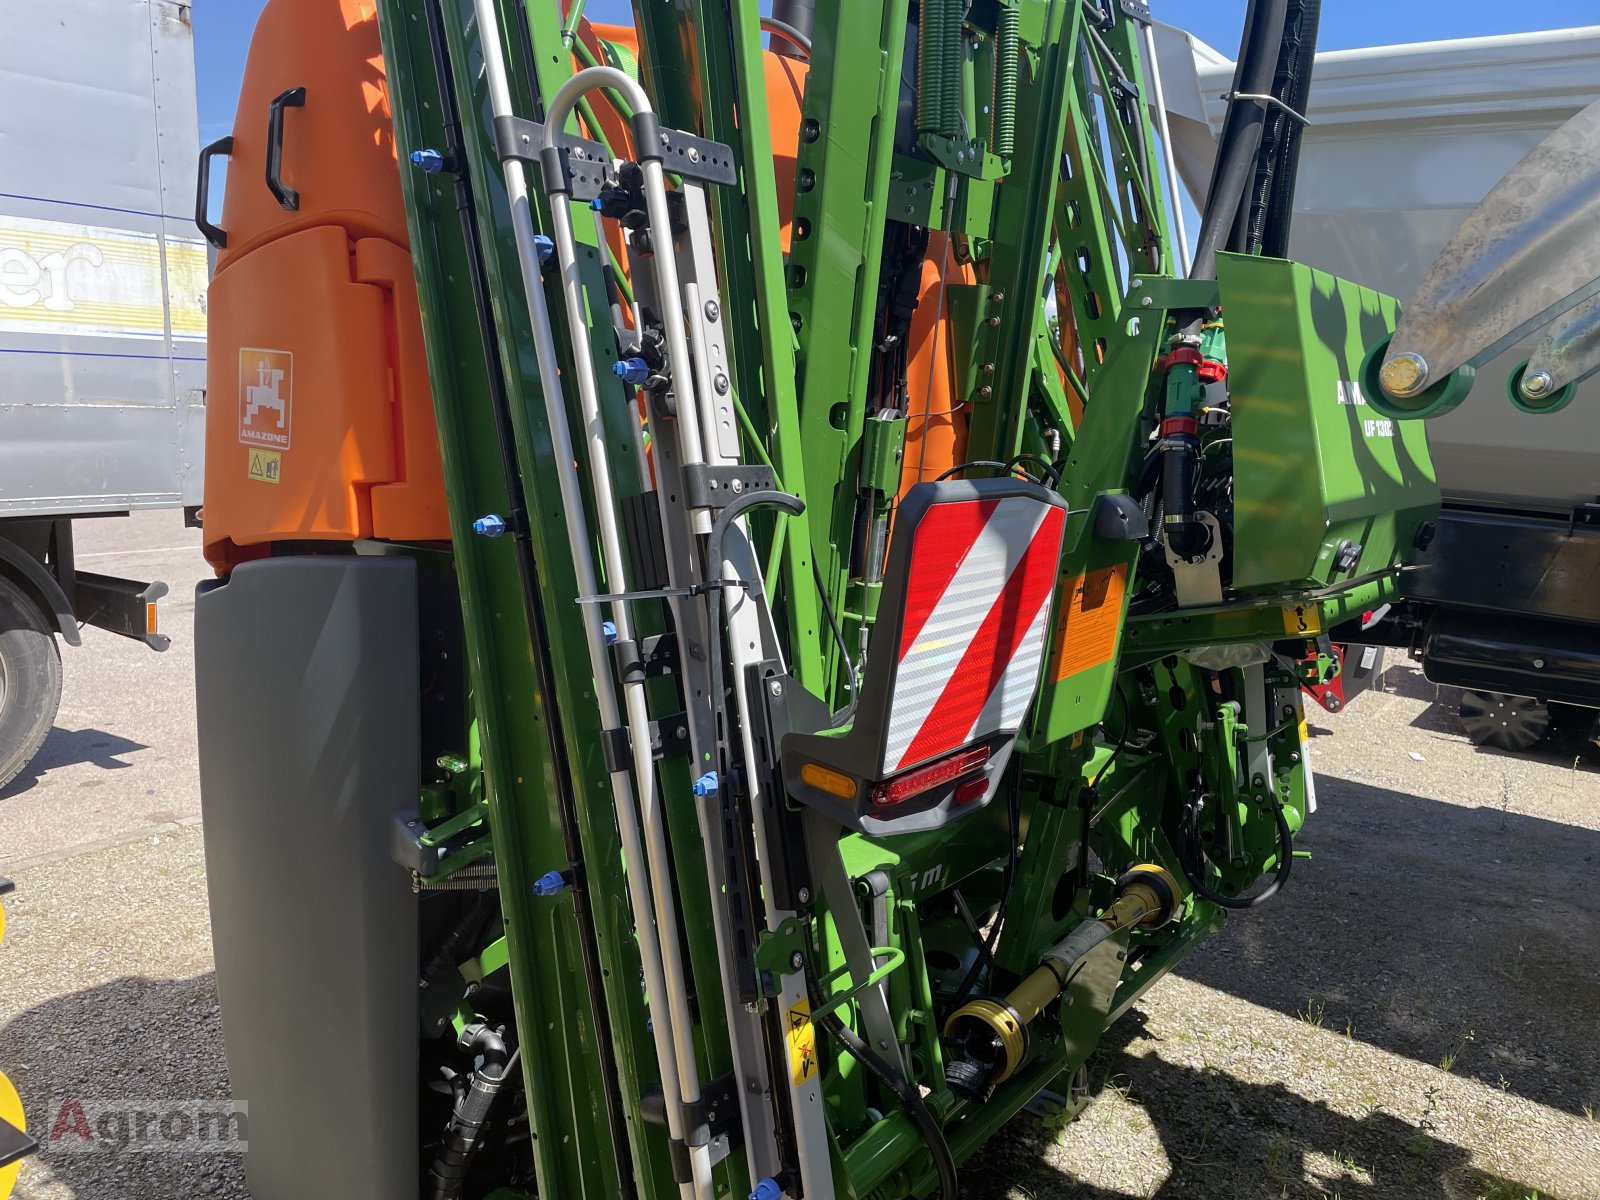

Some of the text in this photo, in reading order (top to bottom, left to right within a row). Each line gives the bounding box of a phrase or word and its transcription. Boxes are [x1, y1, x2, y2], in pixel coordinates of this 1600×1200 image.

[0, 242, 104, 311] er
[1337, 380, 1367, 405] AM
[241, 429, 288, 444] AMAZONE
[1364, 419, 1376, 437] UF
